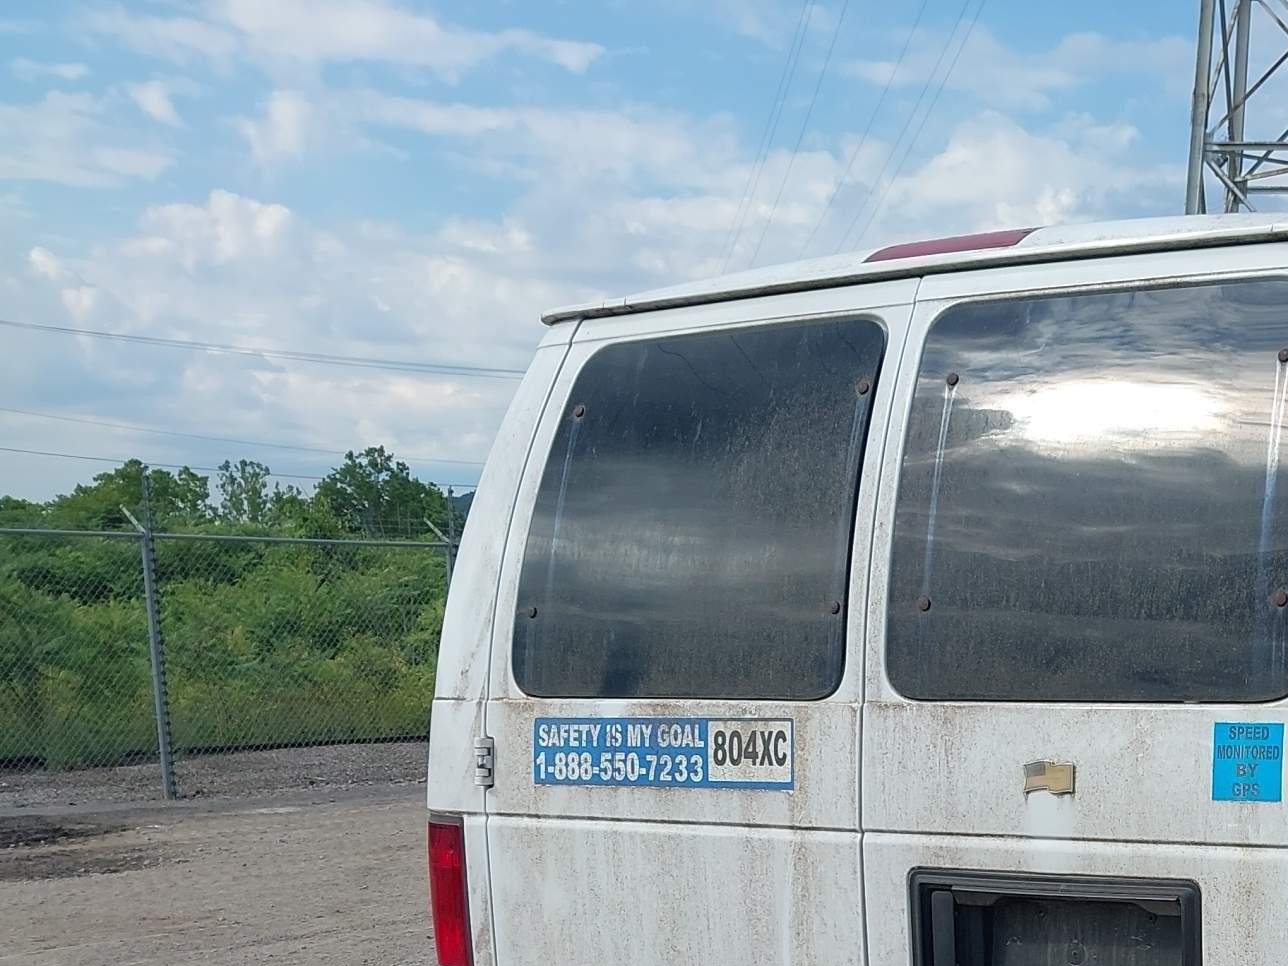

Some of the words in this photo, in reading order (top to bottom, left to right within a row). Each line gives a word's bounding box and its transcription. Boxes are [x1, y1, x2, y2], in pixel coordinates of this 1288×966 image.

[539, 724, 600, 747] SAFETY
[606, 725, 622, 747] IS
[627, 725, 652, 747] MY
[657, 724, 704, 747] GOAL
[1229, 726, 1269, 740] SPEED
[713, 730, 787, 767] 804XC
[1217, 745, 1280, 760] MONITORED
[536, 752, 704, 782] 1-888-550-7233
[1236, 764, 1258, 777] BY
[1232, 782, 1261, 797] GPS
